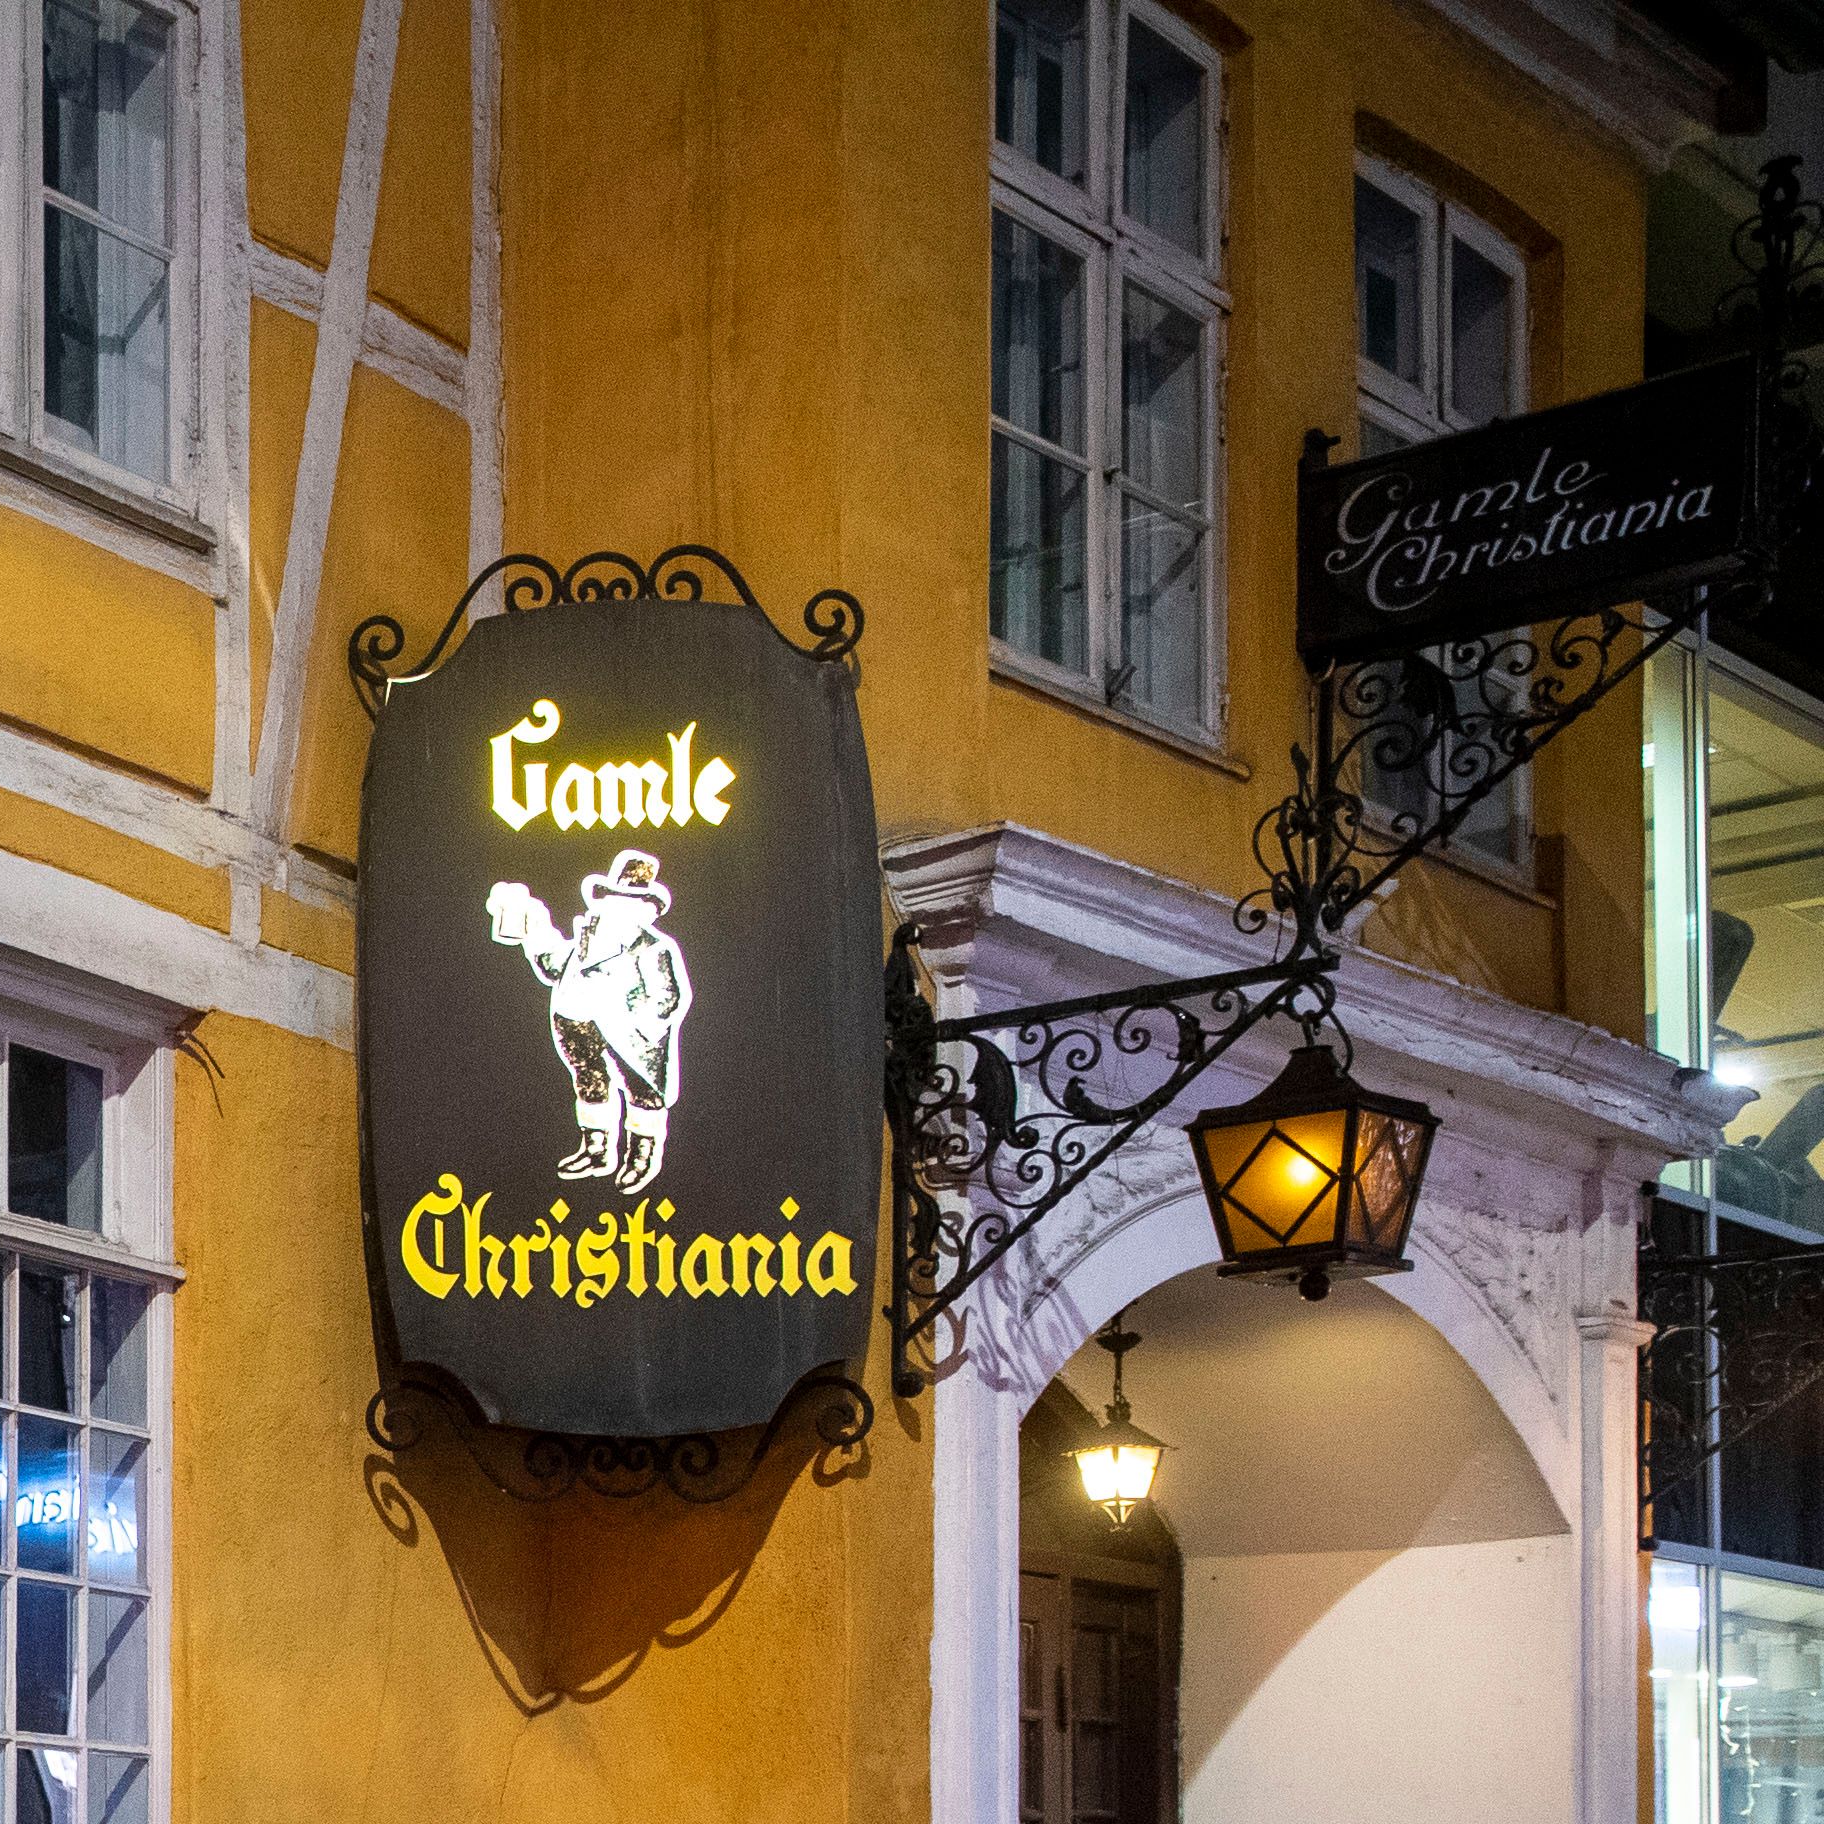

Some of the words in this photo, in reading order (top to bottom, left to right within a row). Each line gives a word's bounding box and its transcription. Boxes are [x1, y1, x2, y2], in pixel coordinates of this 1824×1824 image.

[1325, 447, 1607, 575] Gamle
[1366, 479, 1712, 612] Christiania
[488, 699, 738, 832] Gamle
[400, 1173, 859, 1309] Christiania
